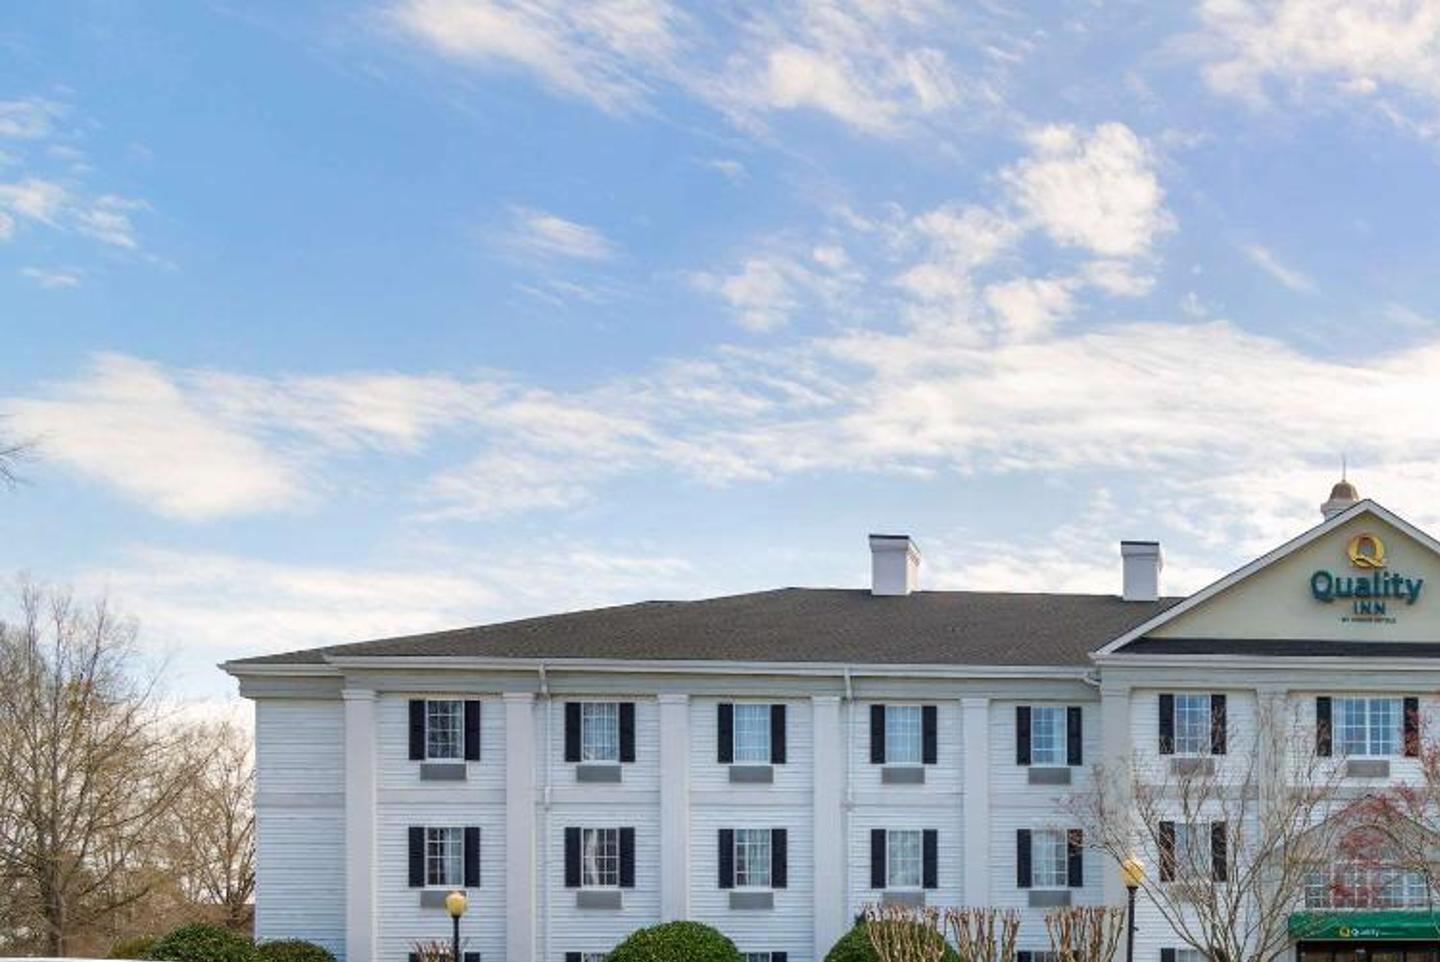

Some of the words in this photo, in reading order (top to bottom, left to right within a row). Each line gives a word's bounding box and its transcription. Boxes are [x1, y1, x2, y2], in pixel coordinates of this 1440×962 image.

[1348, 532, 1386, 568] Q
[1310, 569, 1424, 606] Quality
[1353, 600, 1386, 615] INN
